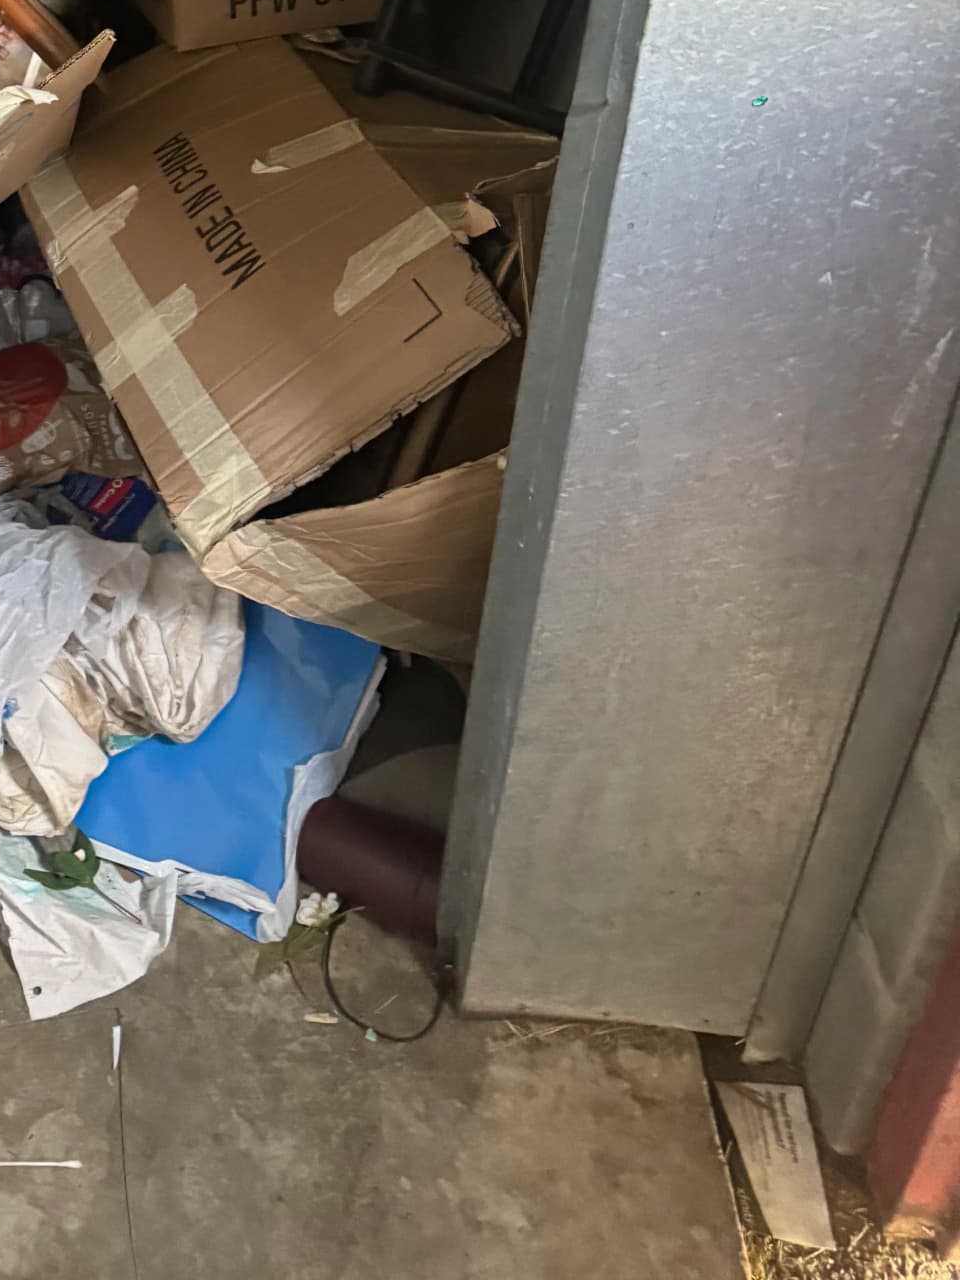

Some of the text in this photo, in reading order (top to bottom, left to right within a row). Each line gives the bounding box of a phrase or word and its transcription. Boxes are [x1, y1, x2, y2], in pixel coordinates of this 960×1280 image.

[152, 131, 267, 290] MADE IN CHINA
